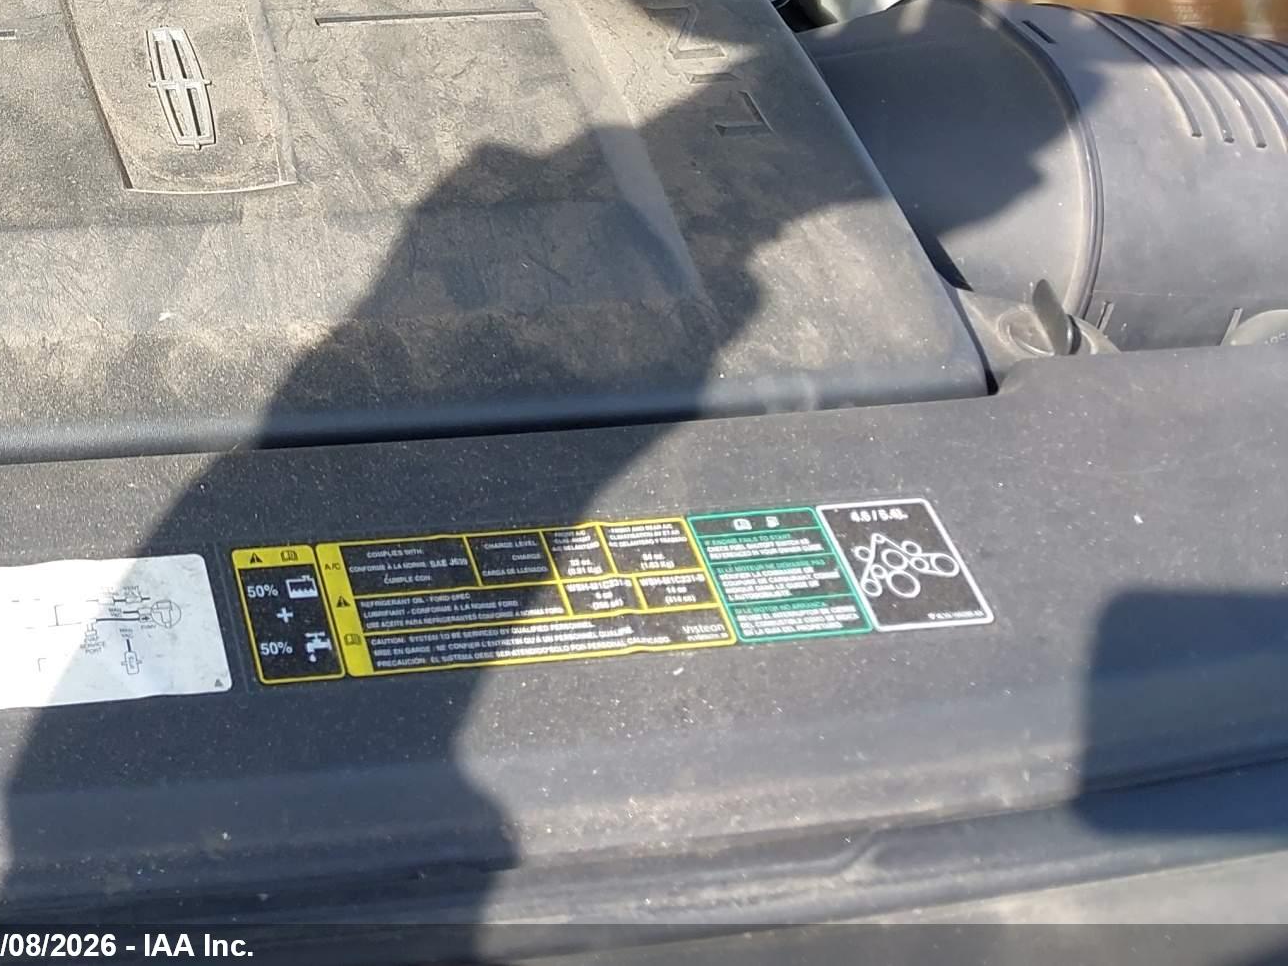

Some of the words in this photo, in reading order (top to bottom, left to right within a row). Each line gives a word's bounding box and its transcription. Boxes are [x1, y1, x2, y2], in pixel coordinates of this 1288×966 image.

[247, 584, 278, 598] 50%
[682, 623, 725, 634] Visteon
[260, 641, 293, 655] 50%
